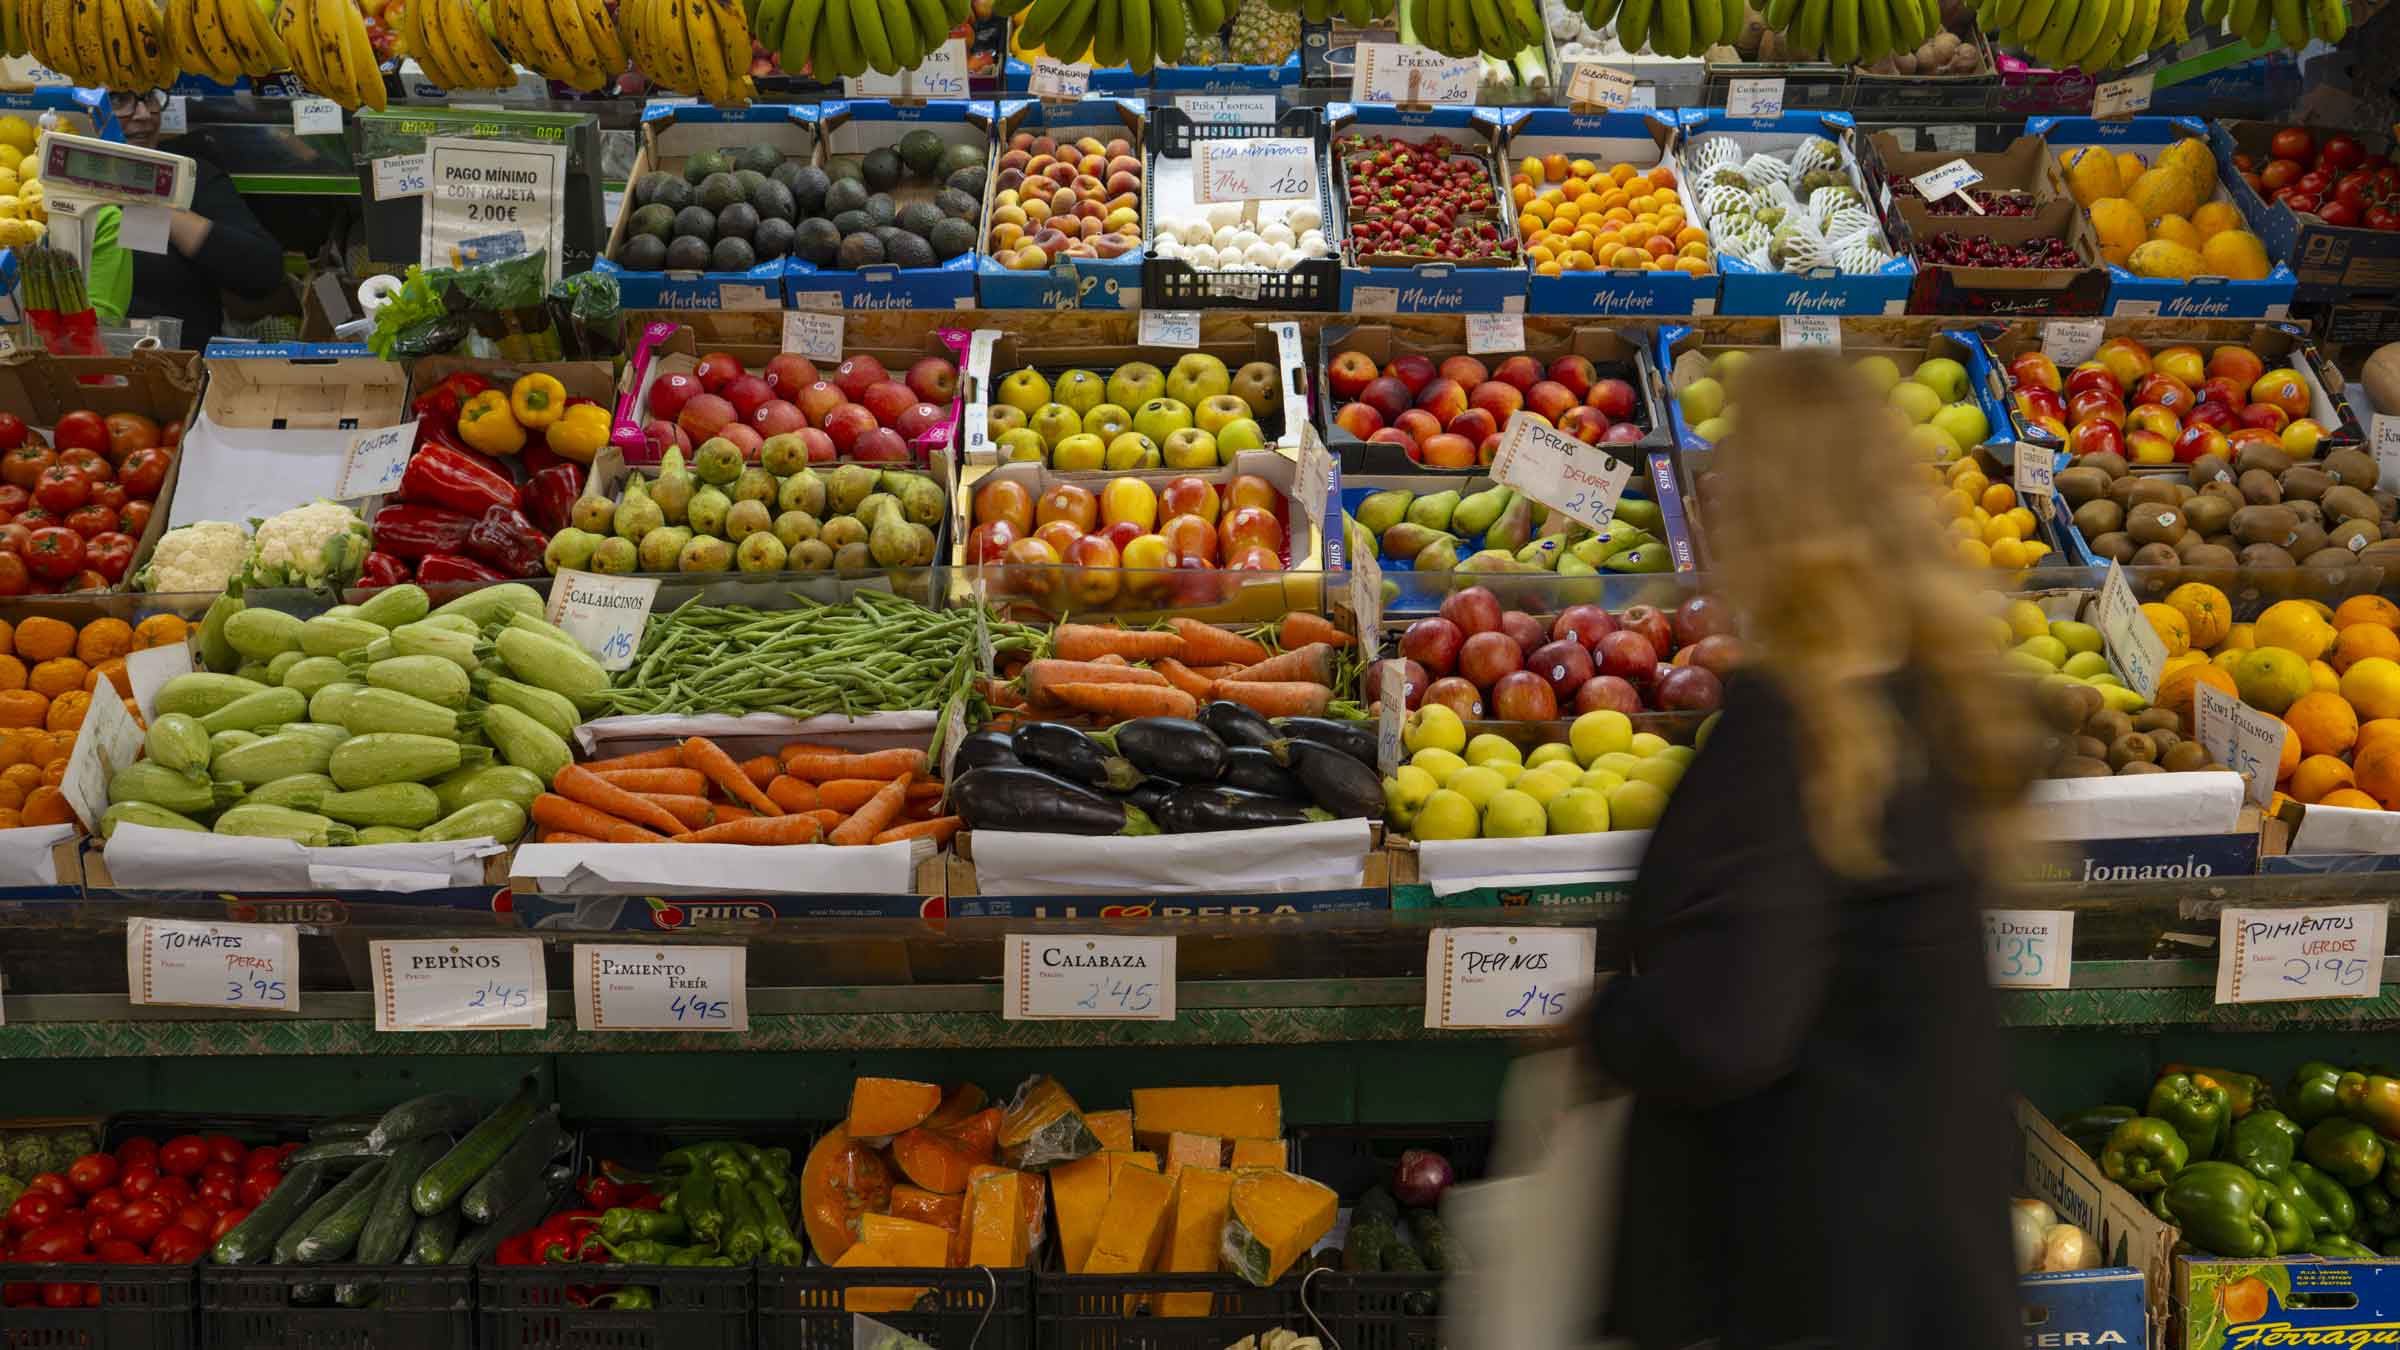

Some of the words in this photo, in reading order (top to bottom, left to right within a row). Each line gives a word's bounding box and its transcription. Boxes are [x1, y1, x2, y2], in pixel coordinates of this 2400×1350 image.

[445, 166, 482, 181] PAGO
[485, 167, 538, 185] MÍNIMO
[447, 184, 476, 198] CON
[479, 186, 536, 203] TARJETA
[467, 203, 518, 223] 2,00€
[1401, 287, 1463, 311] Marlene
[1593, 289, 1655, 315] Marlene
[1784, 290, 1848, 312] Marlene
[2167, 297, 2230, 318] Marlene
[1531, 425, 1577, 456] PERAS
[1565, 490, 1614, 526] 2'95
[2082, 855, 2212, 884] Jomarolo
[2001, 922, 2048, 936] DULCE
[2245, 916, 2354, 945] PIMIENTOS
[160, 931, 243, 950] TOMATES
[2302, 939, 2358, 956] VERDES
[224, 953, 273, 972] PERAS
[412, 955, 501, 969] PEPINOS
[602, 959, 686, 977] PIMIENTO
[1042, 947, 1147, 968] CALABAZA
[1460, 951, 1549, 974] PEPINOS
[668, 976, 708, 990] FREÍR
[2282, 958, 2368, 986] 2'95
[226, 969, 286, 1001] 3'95
[468, 978, 529, 1007] 2'45
[1077, 975, 1160, 1011] 2'45
[671, 994, 729, 1021] 4'95
[1505, 985, 1567, 1018] 2'45
